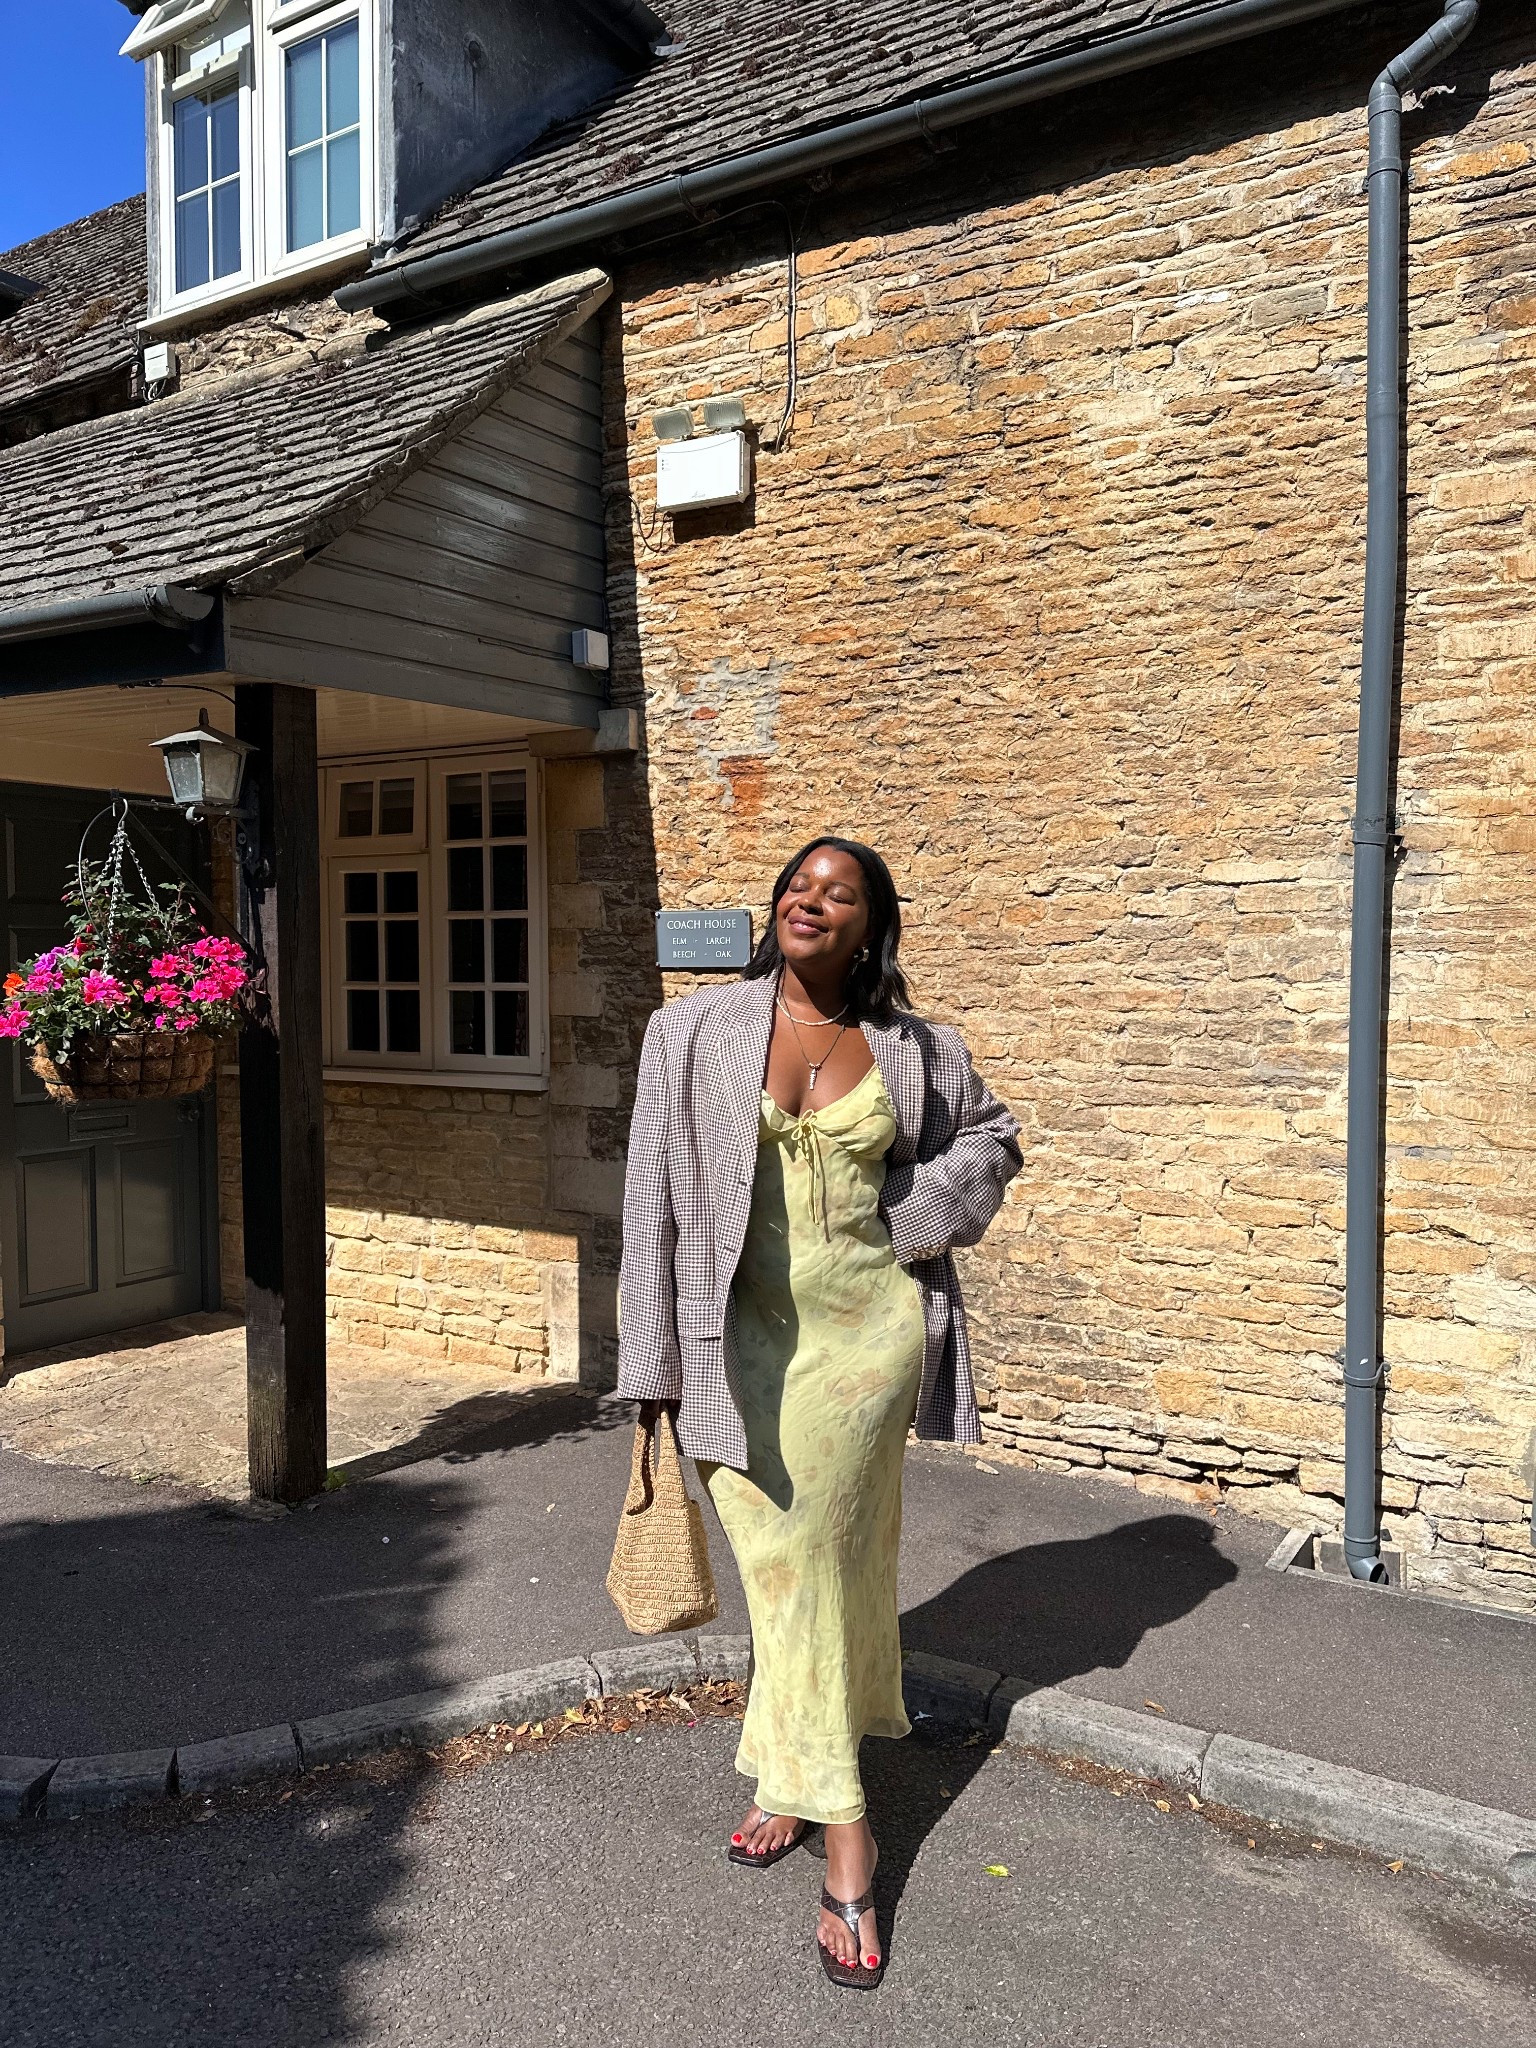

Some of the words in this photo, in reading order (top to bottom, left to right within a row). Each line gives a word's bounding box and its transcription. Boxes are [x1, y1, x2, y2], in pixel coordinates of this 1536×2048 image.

[667, 920, 700, 929] COACH
[704, 919, 736, 929] HOUSE
[706, 937, 731, 945] LARCH
[715, 950, 732, 958] OAK
